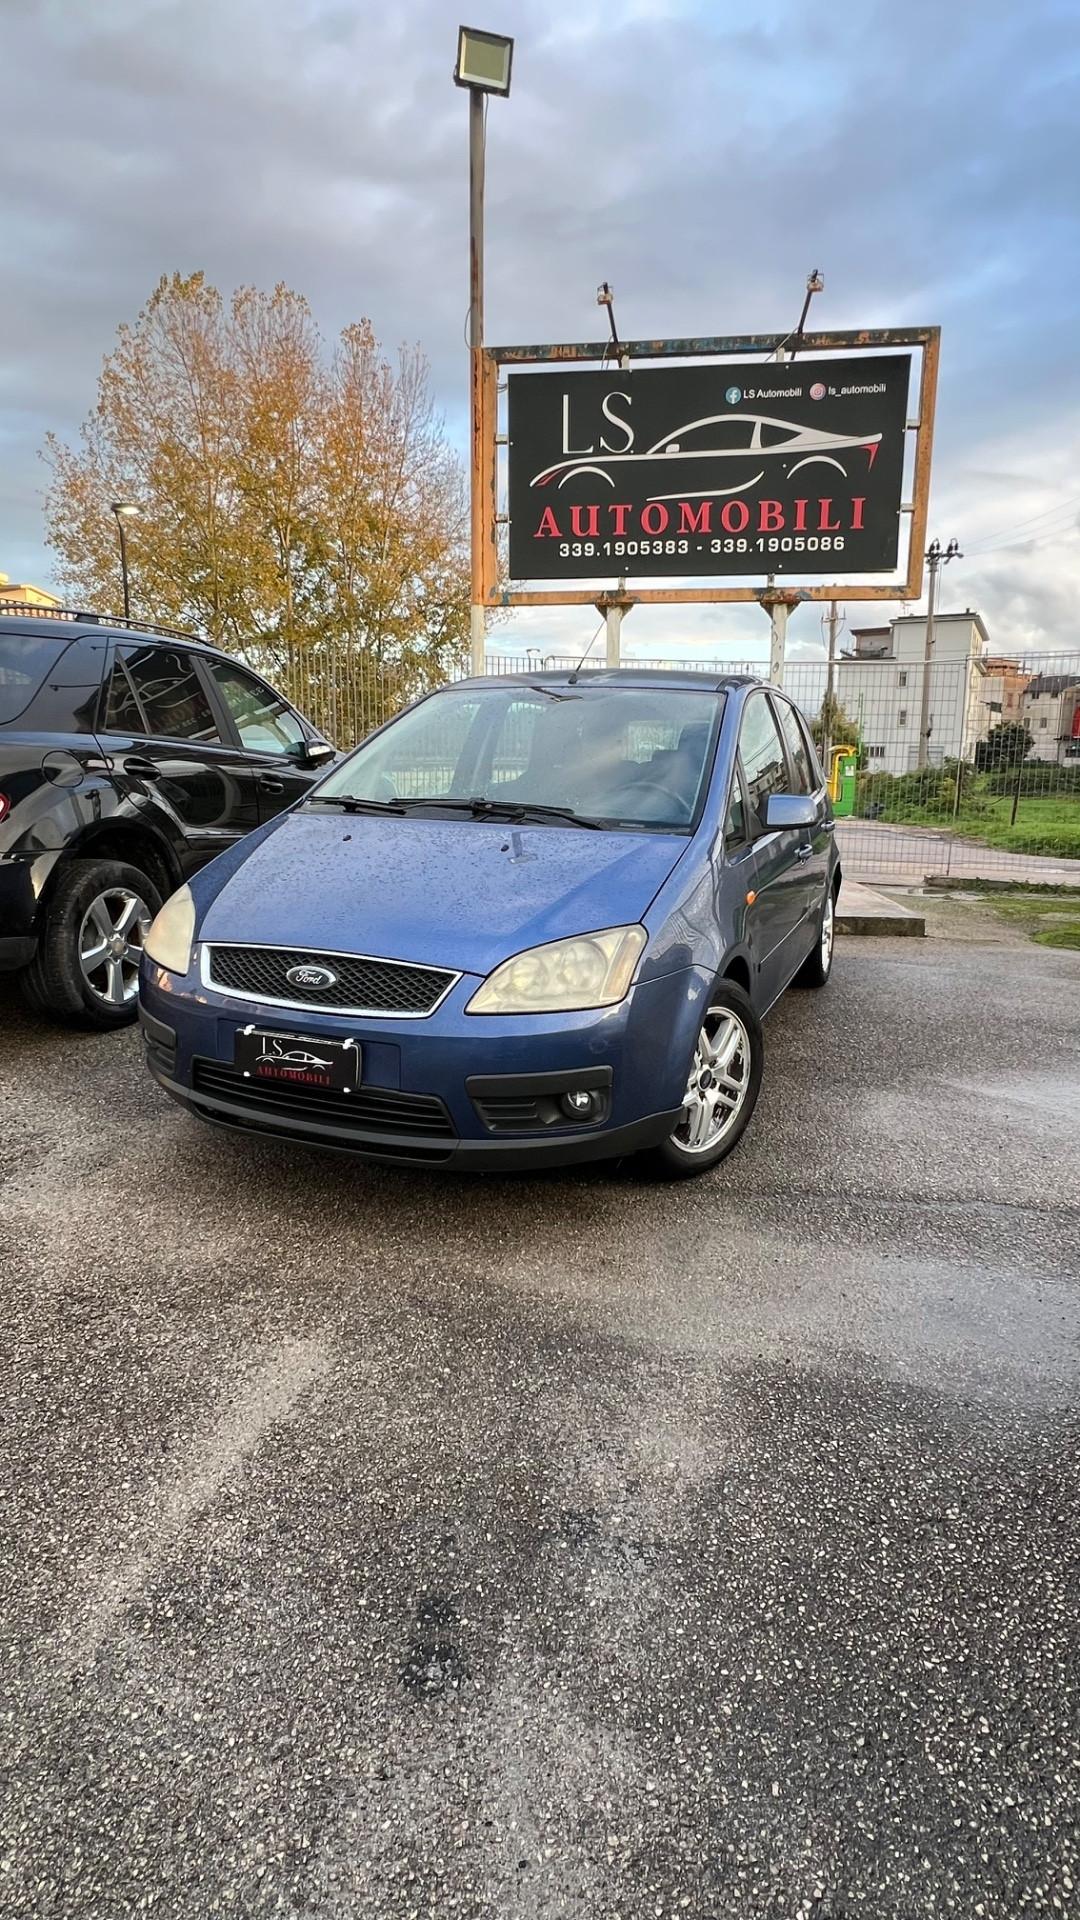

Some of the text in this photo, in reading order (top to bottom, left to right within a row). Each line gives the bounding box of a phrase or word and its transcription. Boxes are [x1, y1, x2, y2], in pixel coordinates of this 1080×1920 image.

[743, 387, 803, 399] LS Automobili
[828, 383, 887, 397] ls_automobili
[533, 497, 867, 538] AUTOMOBILI
[559, 540, 689, 557] 339.1905383
[710, 536, 845, 554] 339.1905086
[295, 969, 323, 985] Ford
[256, 1065, 331, 1085] AUTOMOBILI
